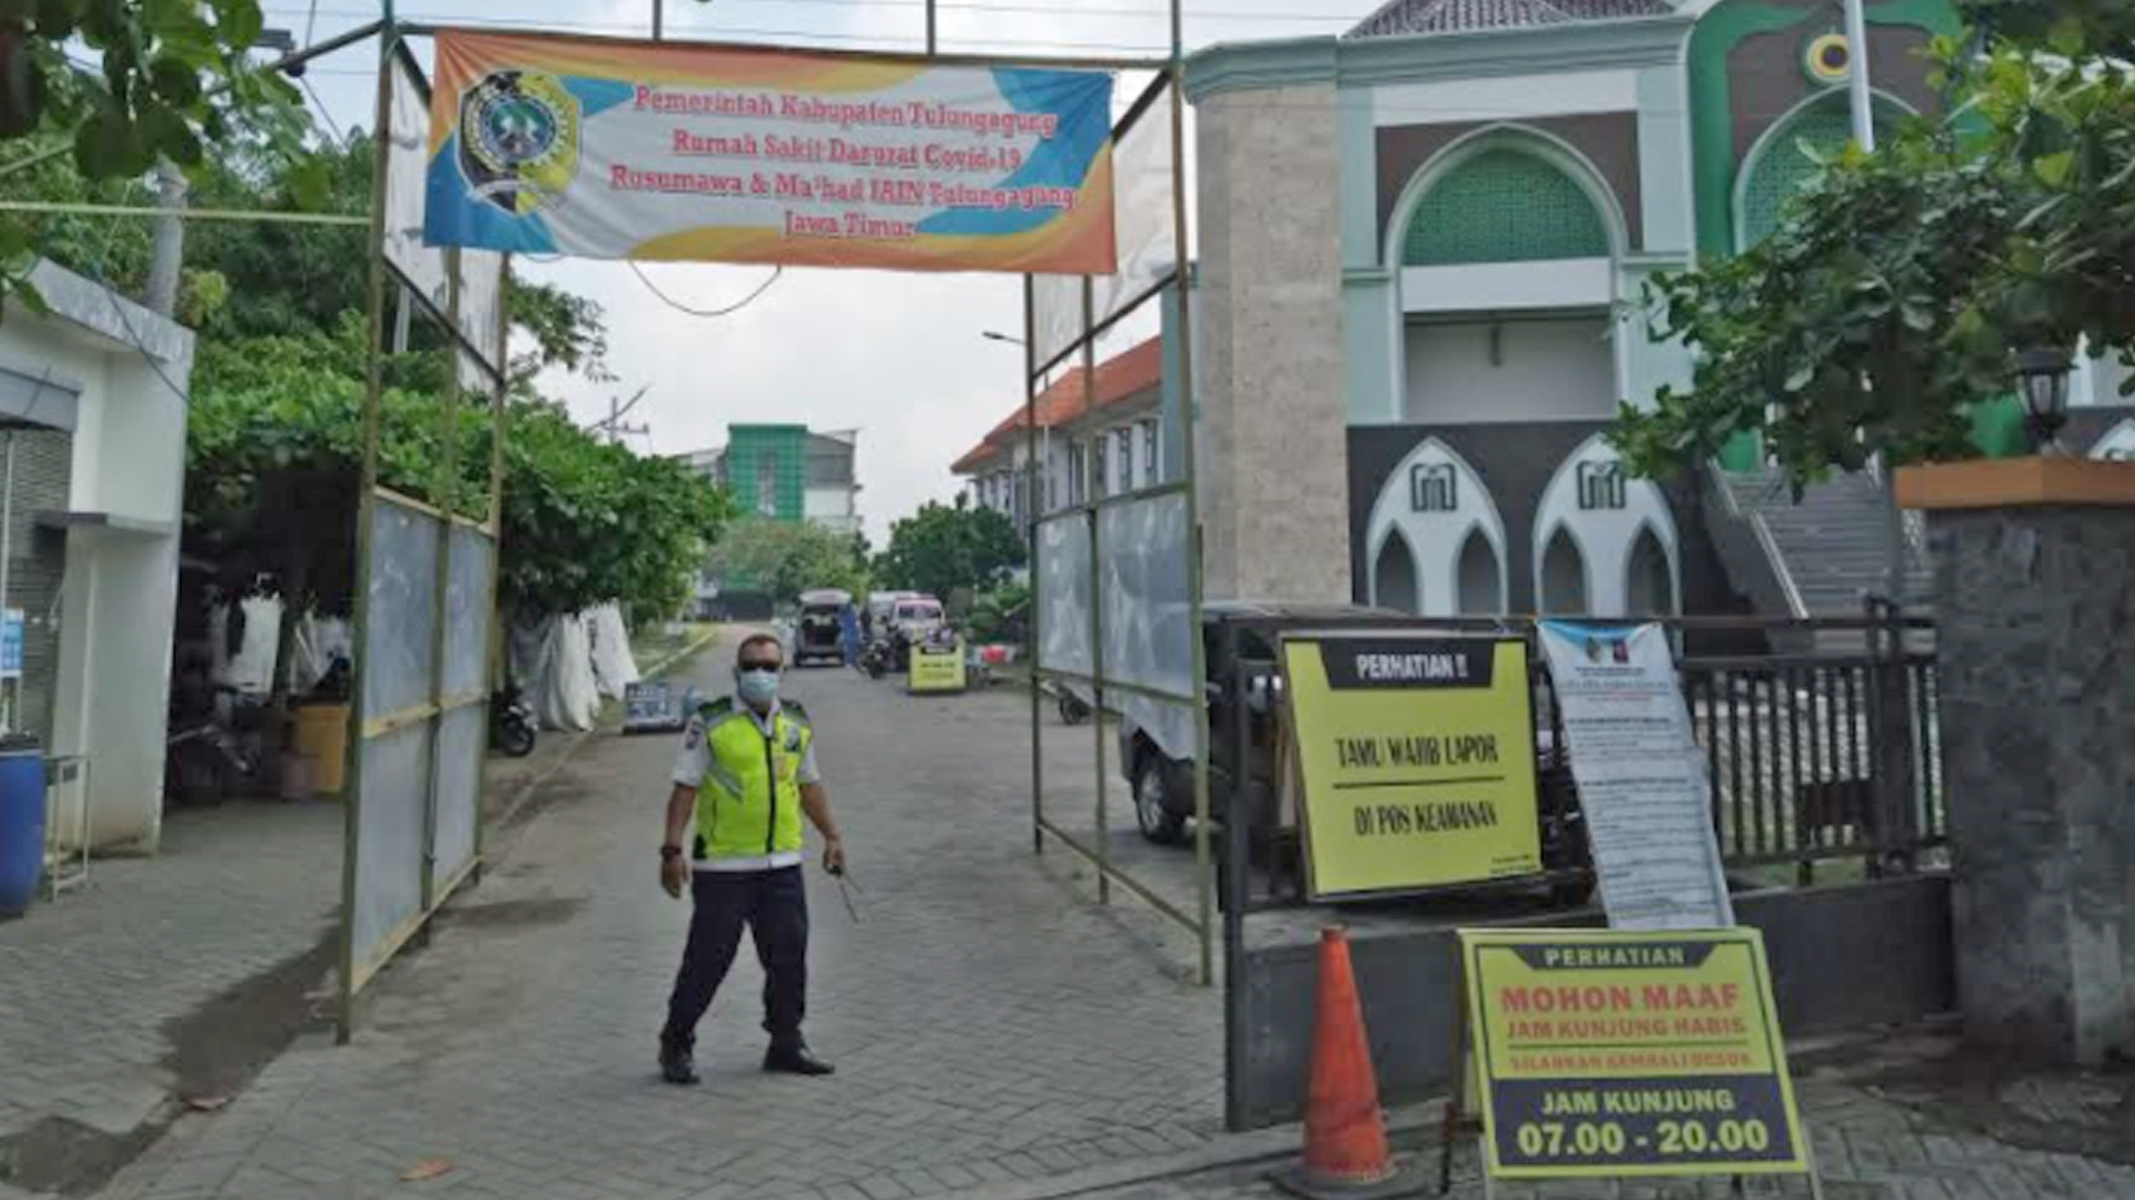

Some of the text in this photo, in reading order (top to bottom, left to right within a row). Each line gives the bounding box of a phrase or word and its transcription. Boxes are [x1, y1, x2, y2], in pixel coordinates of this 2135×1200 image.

[635, 85, 772, 115] Pemerintah
[780, 94, 903, 127] Kabupaten
[673, 129, 757, 156] Rumah
[764, 134, 823, 161] Sakit
[828, 138, 918, 167] Darurat
[751, 172, 768, 197] &
[784, 210, 916, 239] Jawa Timur
[1356, 654, 1453, 679] PERHATIAN
[1334, 733, 1499, 768] TAMU WAJIB LAPOR
[1354, 800, 1498, 836] DI POS KEAMANAN
[1545, 947, 1685, 966] PERHATIAN
[1501, 983, 1739, 1012] MOHON MAAF
[1508, 1015, 1747, 1039] JAM KUNJUNG HABIS
[1541, 1089, 1736, 1115] JAM KUNJUNG
[1518, 1122, 1625, 1156] 07.00
[1657, 1119, 1768, 1153] 20.00
